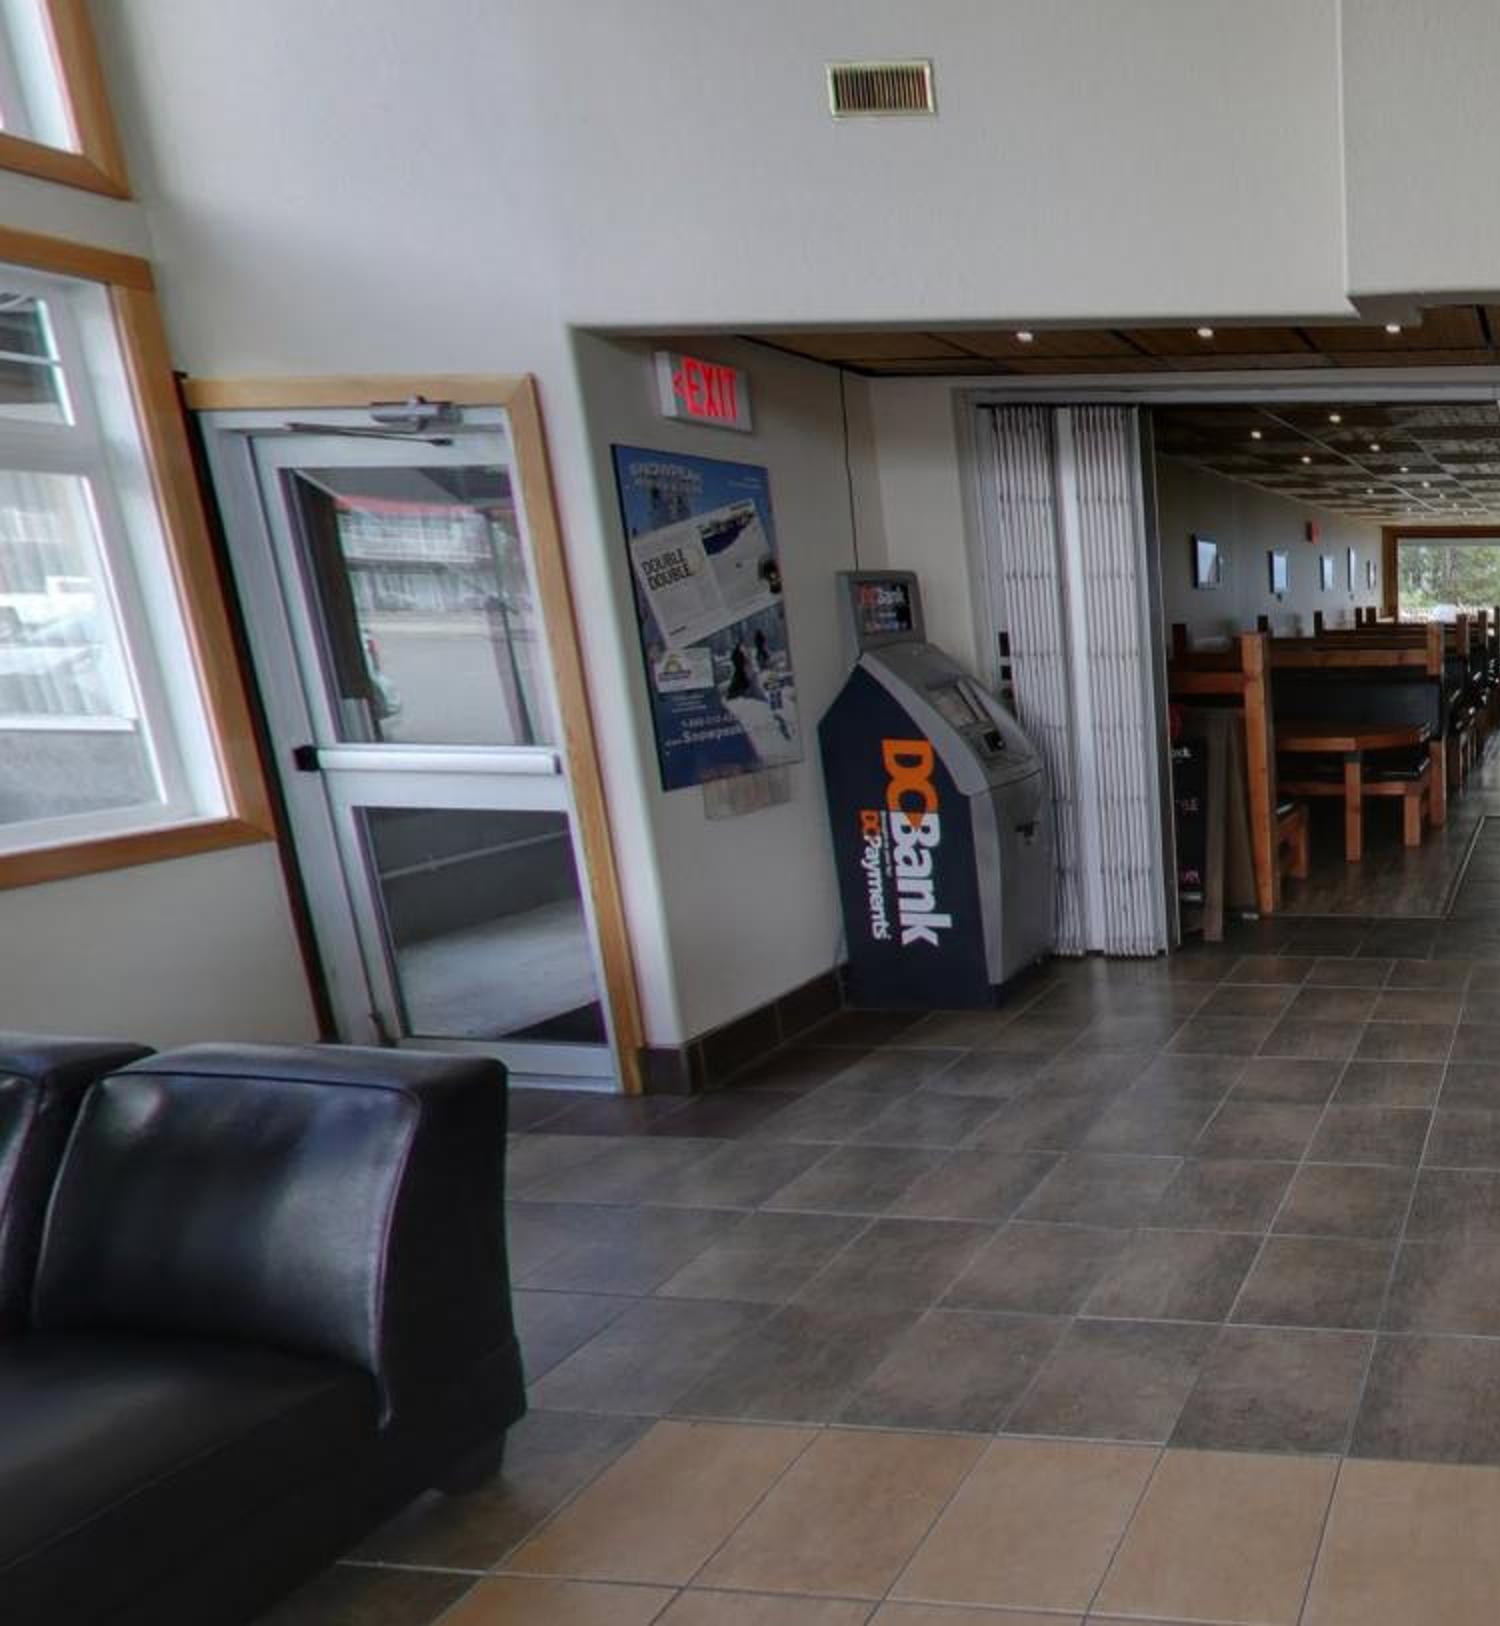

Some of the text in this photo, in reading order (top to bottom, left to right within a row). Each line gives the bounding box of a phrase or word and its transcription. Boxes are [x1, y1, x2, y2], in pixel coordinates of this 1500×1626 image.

[683, 356, 737, 420] EXIT
[641, 548, 685, 576] DOUBLE
[648, 563, 692, 592] DOUBLE
[860, 810, 888, 940] DCPayments
[881, 739, 953, 947] DCBank
